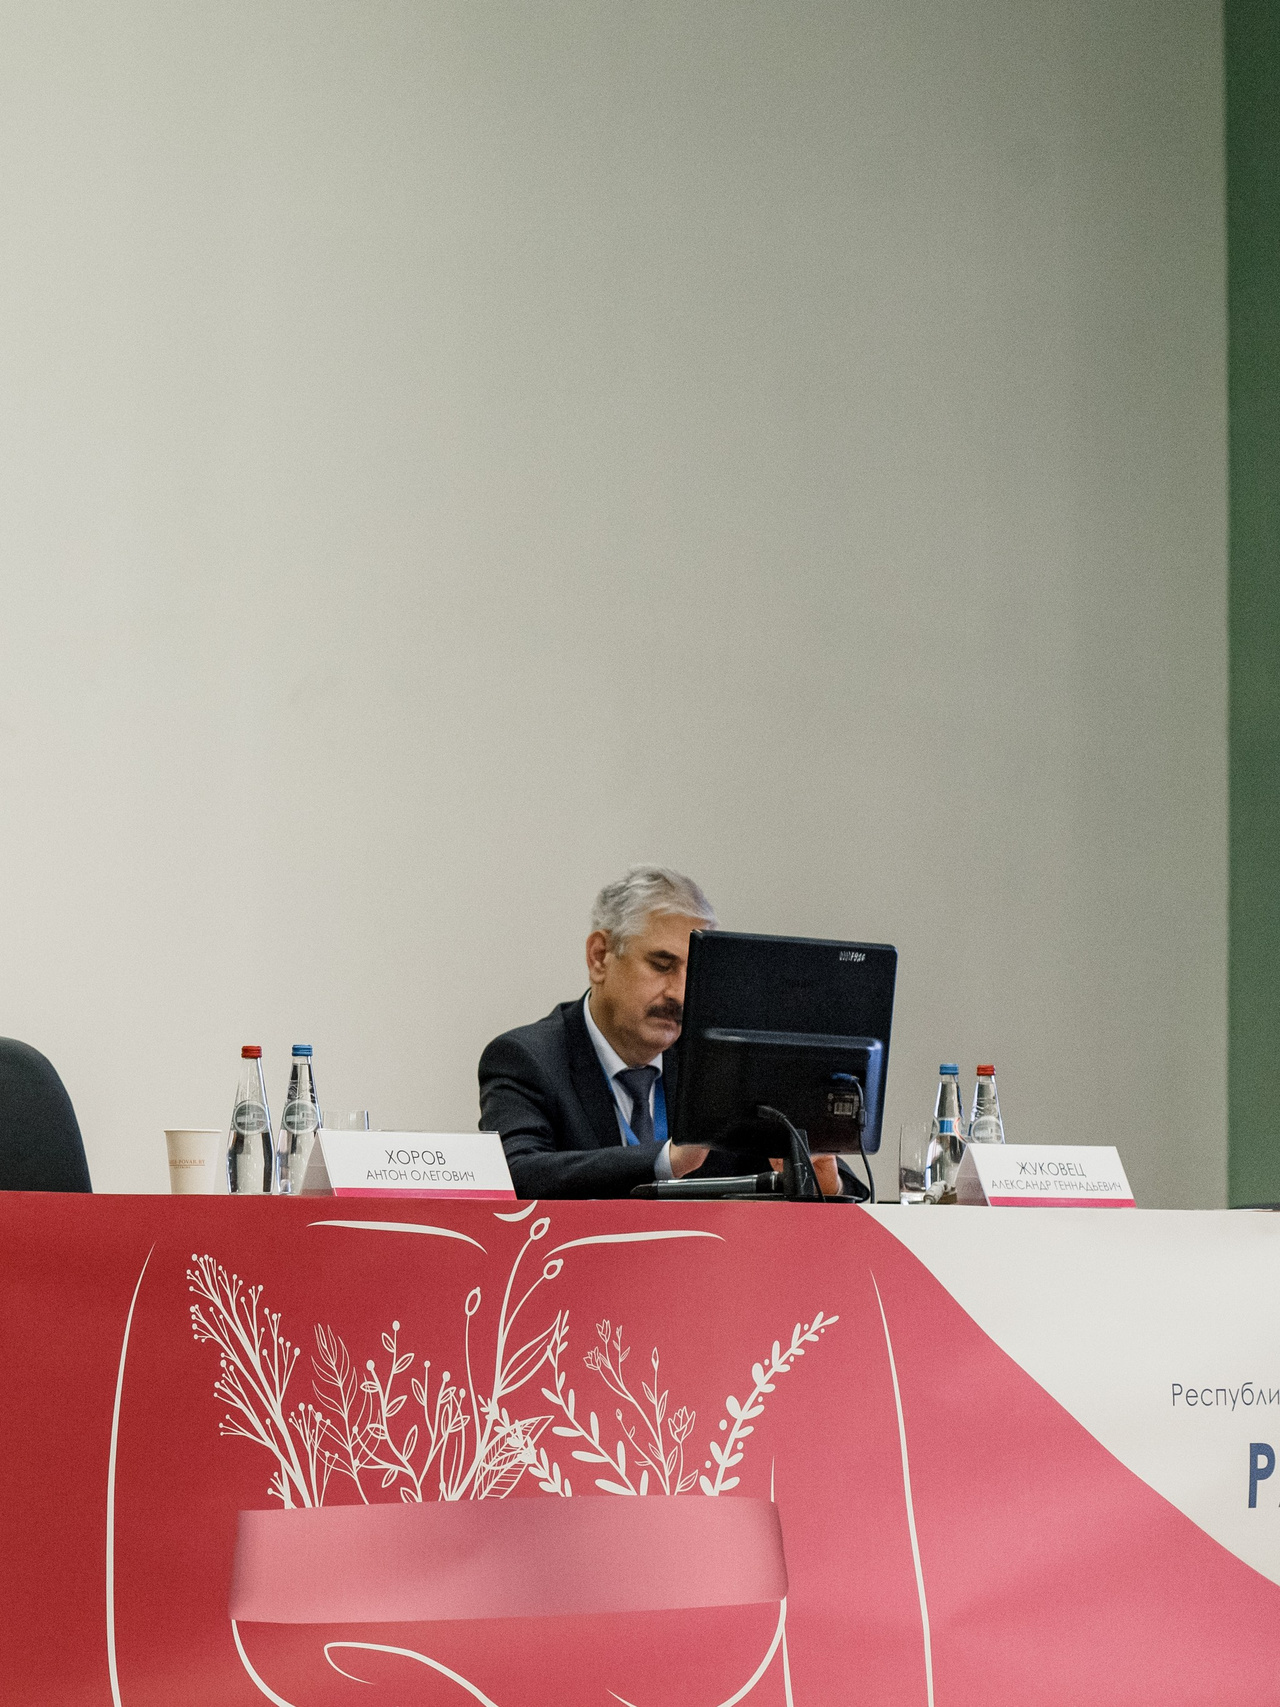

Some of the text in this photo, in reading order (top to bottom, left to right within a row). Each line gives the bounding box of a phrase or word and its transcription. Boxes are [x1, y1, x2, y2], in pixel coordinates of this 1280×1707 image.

[384, 1149, 446, 1166] ХОРОВ
[366, 1169, 476, 1182] АНТОН ОЛЕГОВИЧ
[1016, 1161, 1087, 1178] ЖУКОВЕЦ
[991, 1179, 1123, 1192] АЛЕКСАНДР ГЕННАДЬЕВИЧ
[1171, 1381, 1280, 1412] Республи
[1248, 1442, 1280, 1509] Р
